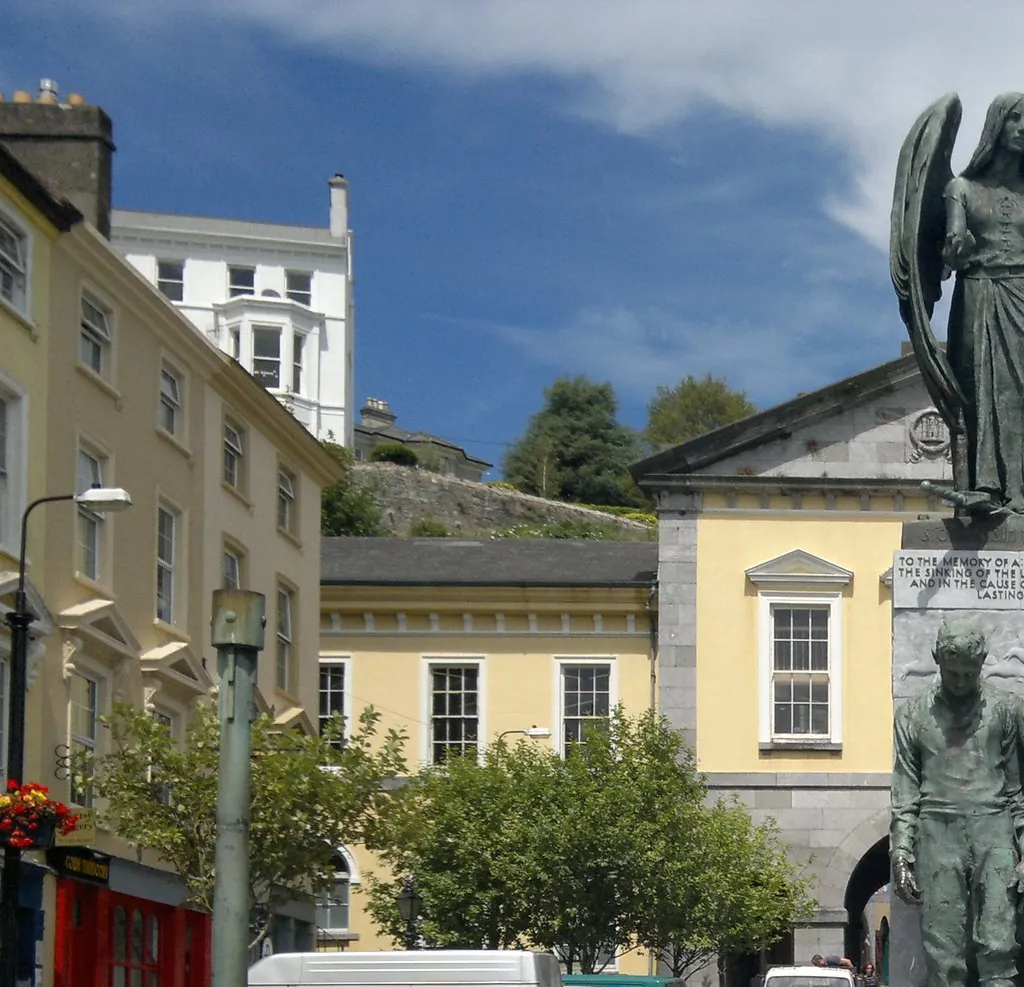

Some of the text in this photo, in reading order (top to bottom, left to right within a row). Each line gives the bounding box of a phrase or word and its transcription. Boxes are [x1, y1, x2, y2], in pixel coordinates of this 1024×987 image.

[899, 557, 914, 567] TO
[917, 557, 937, 567] THE
[943, 557, 992, 568] MEMORY
[995, 558, 1009, 568] OF
[898, 568, 920, 577] THE
[925, 568, 972, 578] SINKING
[976, 569, 991, 578] OF
[995, 569, 1016, 579] THE
[910, 579, 936, 588] AND
[938, 579, 951, 589] IN
[954, 579, 975, 589] THE
[980, 580, 1016, 590] CAUSE
[977, 590, 1024, 600] LASTING
